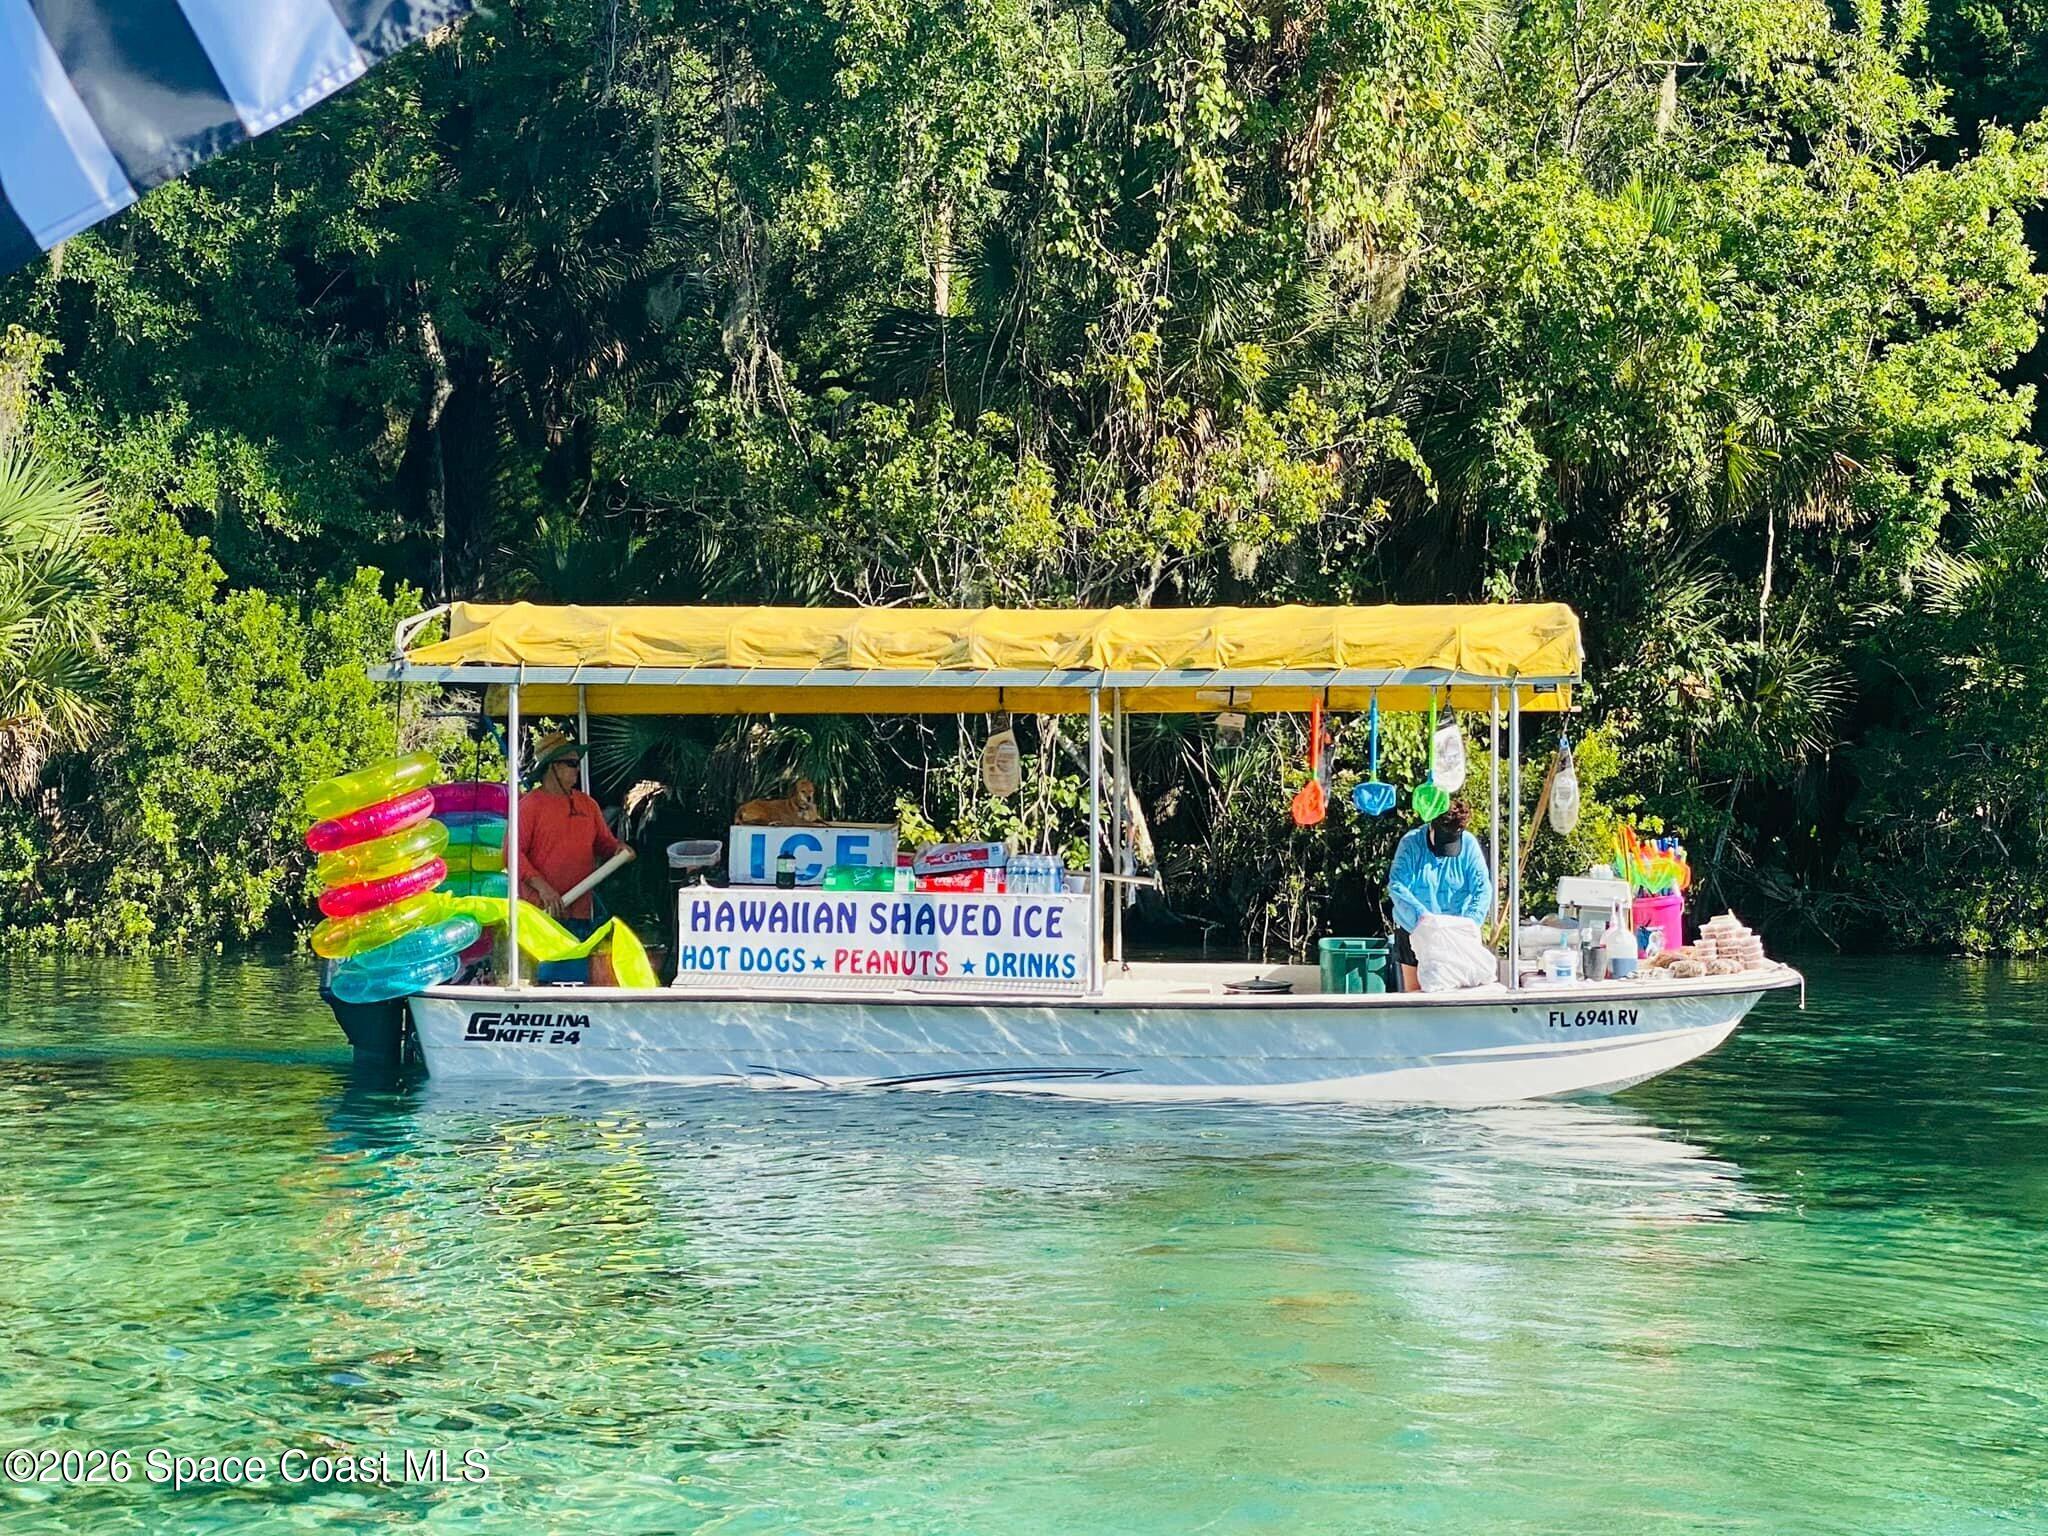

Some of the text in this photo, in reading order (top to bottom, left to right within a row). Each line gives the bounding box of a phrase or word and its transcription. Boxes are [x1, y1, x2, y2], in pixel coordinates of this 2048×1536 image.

[691, 900, 1065, 938] HAWAIIAN SHAVED ICE
[682, 945, 1076, 979] HOT DOGS PEANUTS DRINKS
[1549, 1009, 1639, 1027] FL 6941 RV
[549, 1030, 581, 1044] 24
